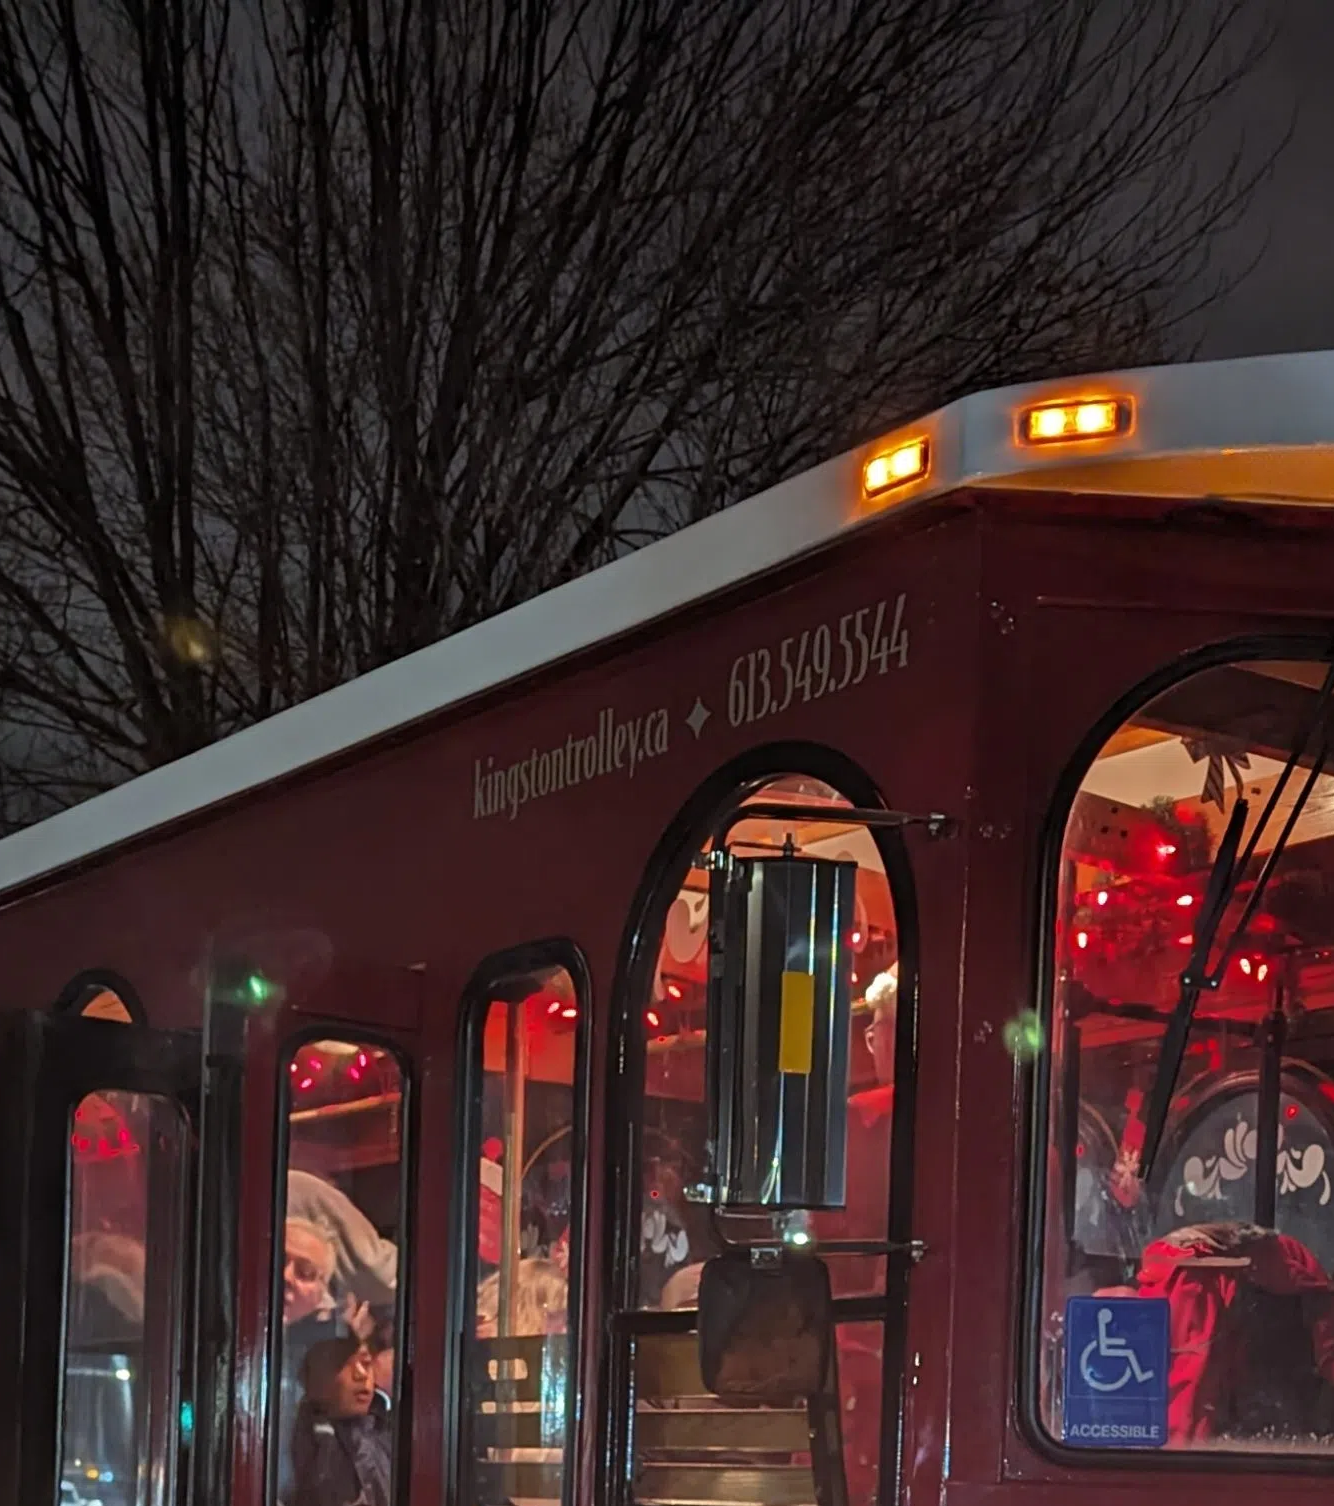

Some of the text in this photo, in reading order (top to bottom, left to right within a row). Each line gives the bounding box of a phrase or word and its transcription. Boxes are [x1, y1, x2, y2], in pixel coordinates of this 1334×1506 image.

[472, 593, 910, 822] kingstontrolley.ca 613.549.5544
[1070, 1424, 1160, 1439] ACCESSIBLE
